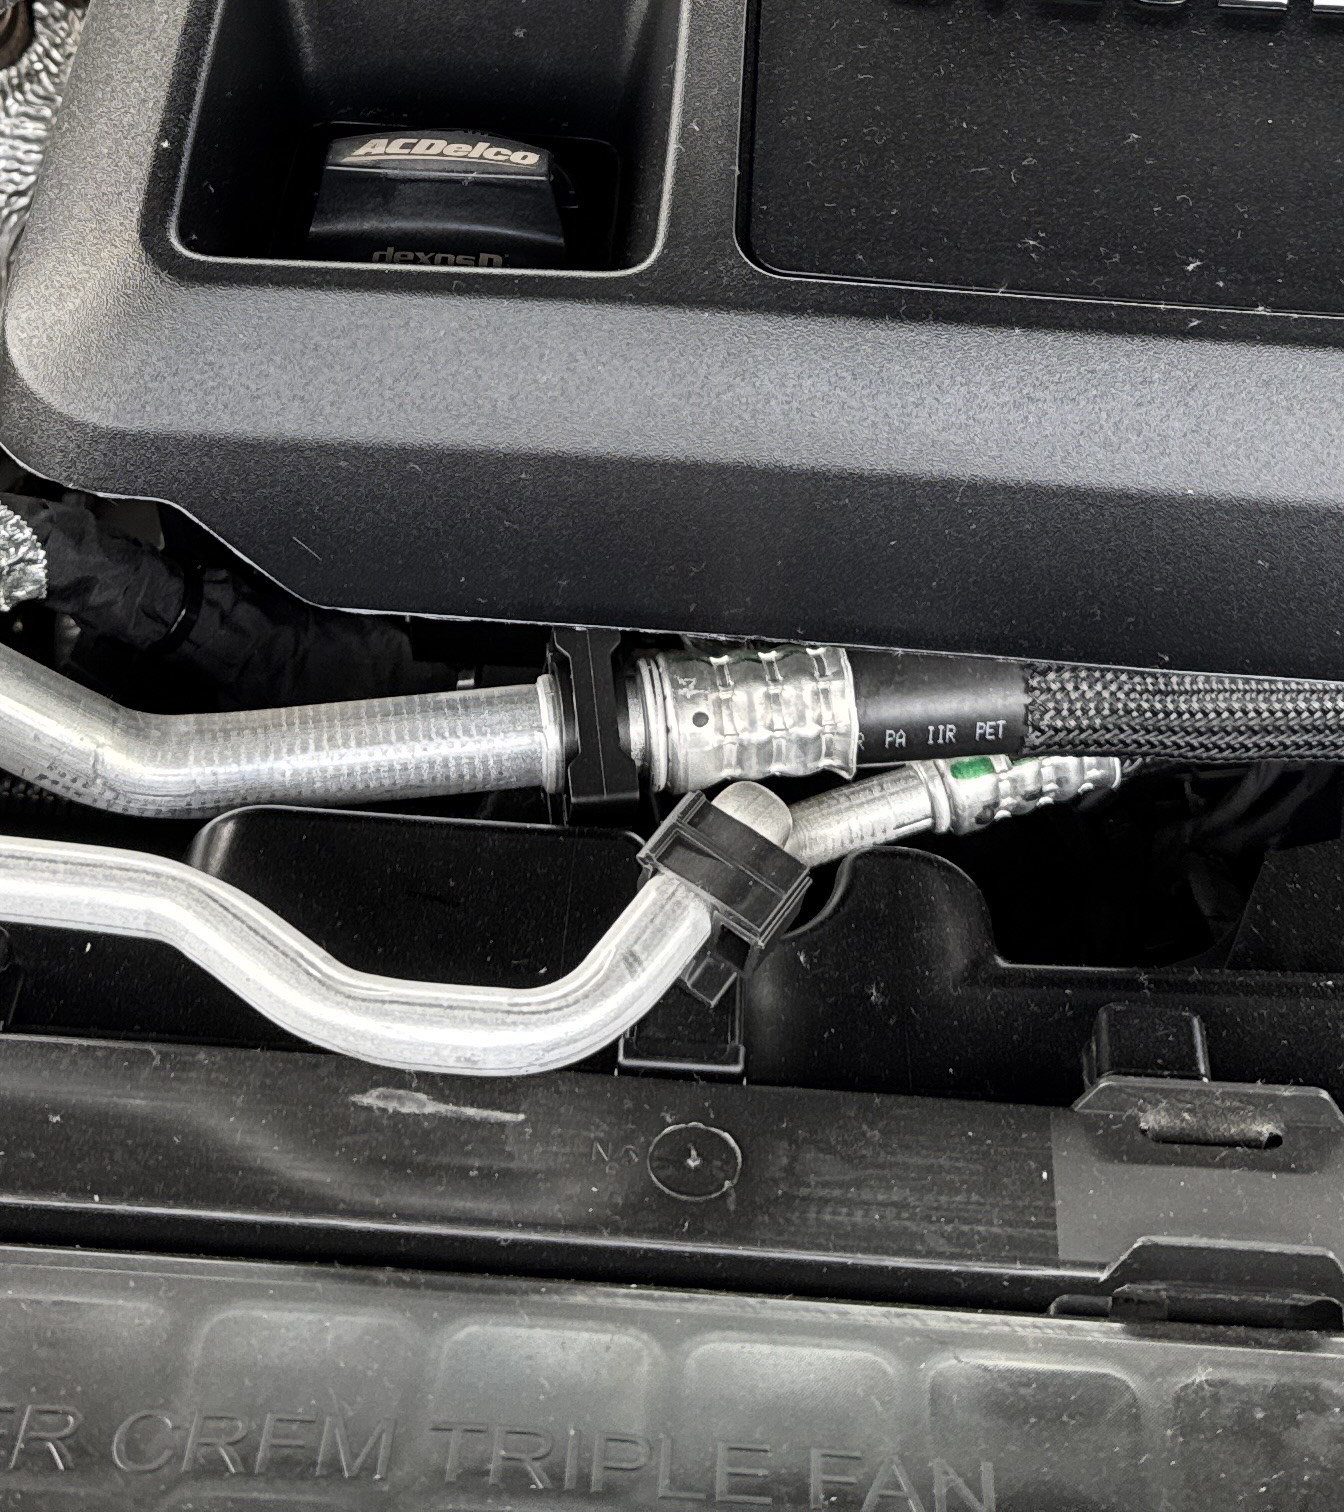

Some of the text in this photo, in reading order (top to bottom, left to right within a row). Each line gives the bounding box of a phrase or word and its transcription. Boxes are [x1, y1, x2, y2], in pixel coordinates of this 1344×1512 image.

[352, 138, 541, 166] ACDelco
[885, 728, 906, 749] PA
[927, 723, 957, 745] IIR
[975, 719, 1006, 741] PET
[110, 1408, 398, 1481] CRFM
[430, 1420, 774, 1507] TRIPLE
[809, 1448, 996, 1512] FAN
